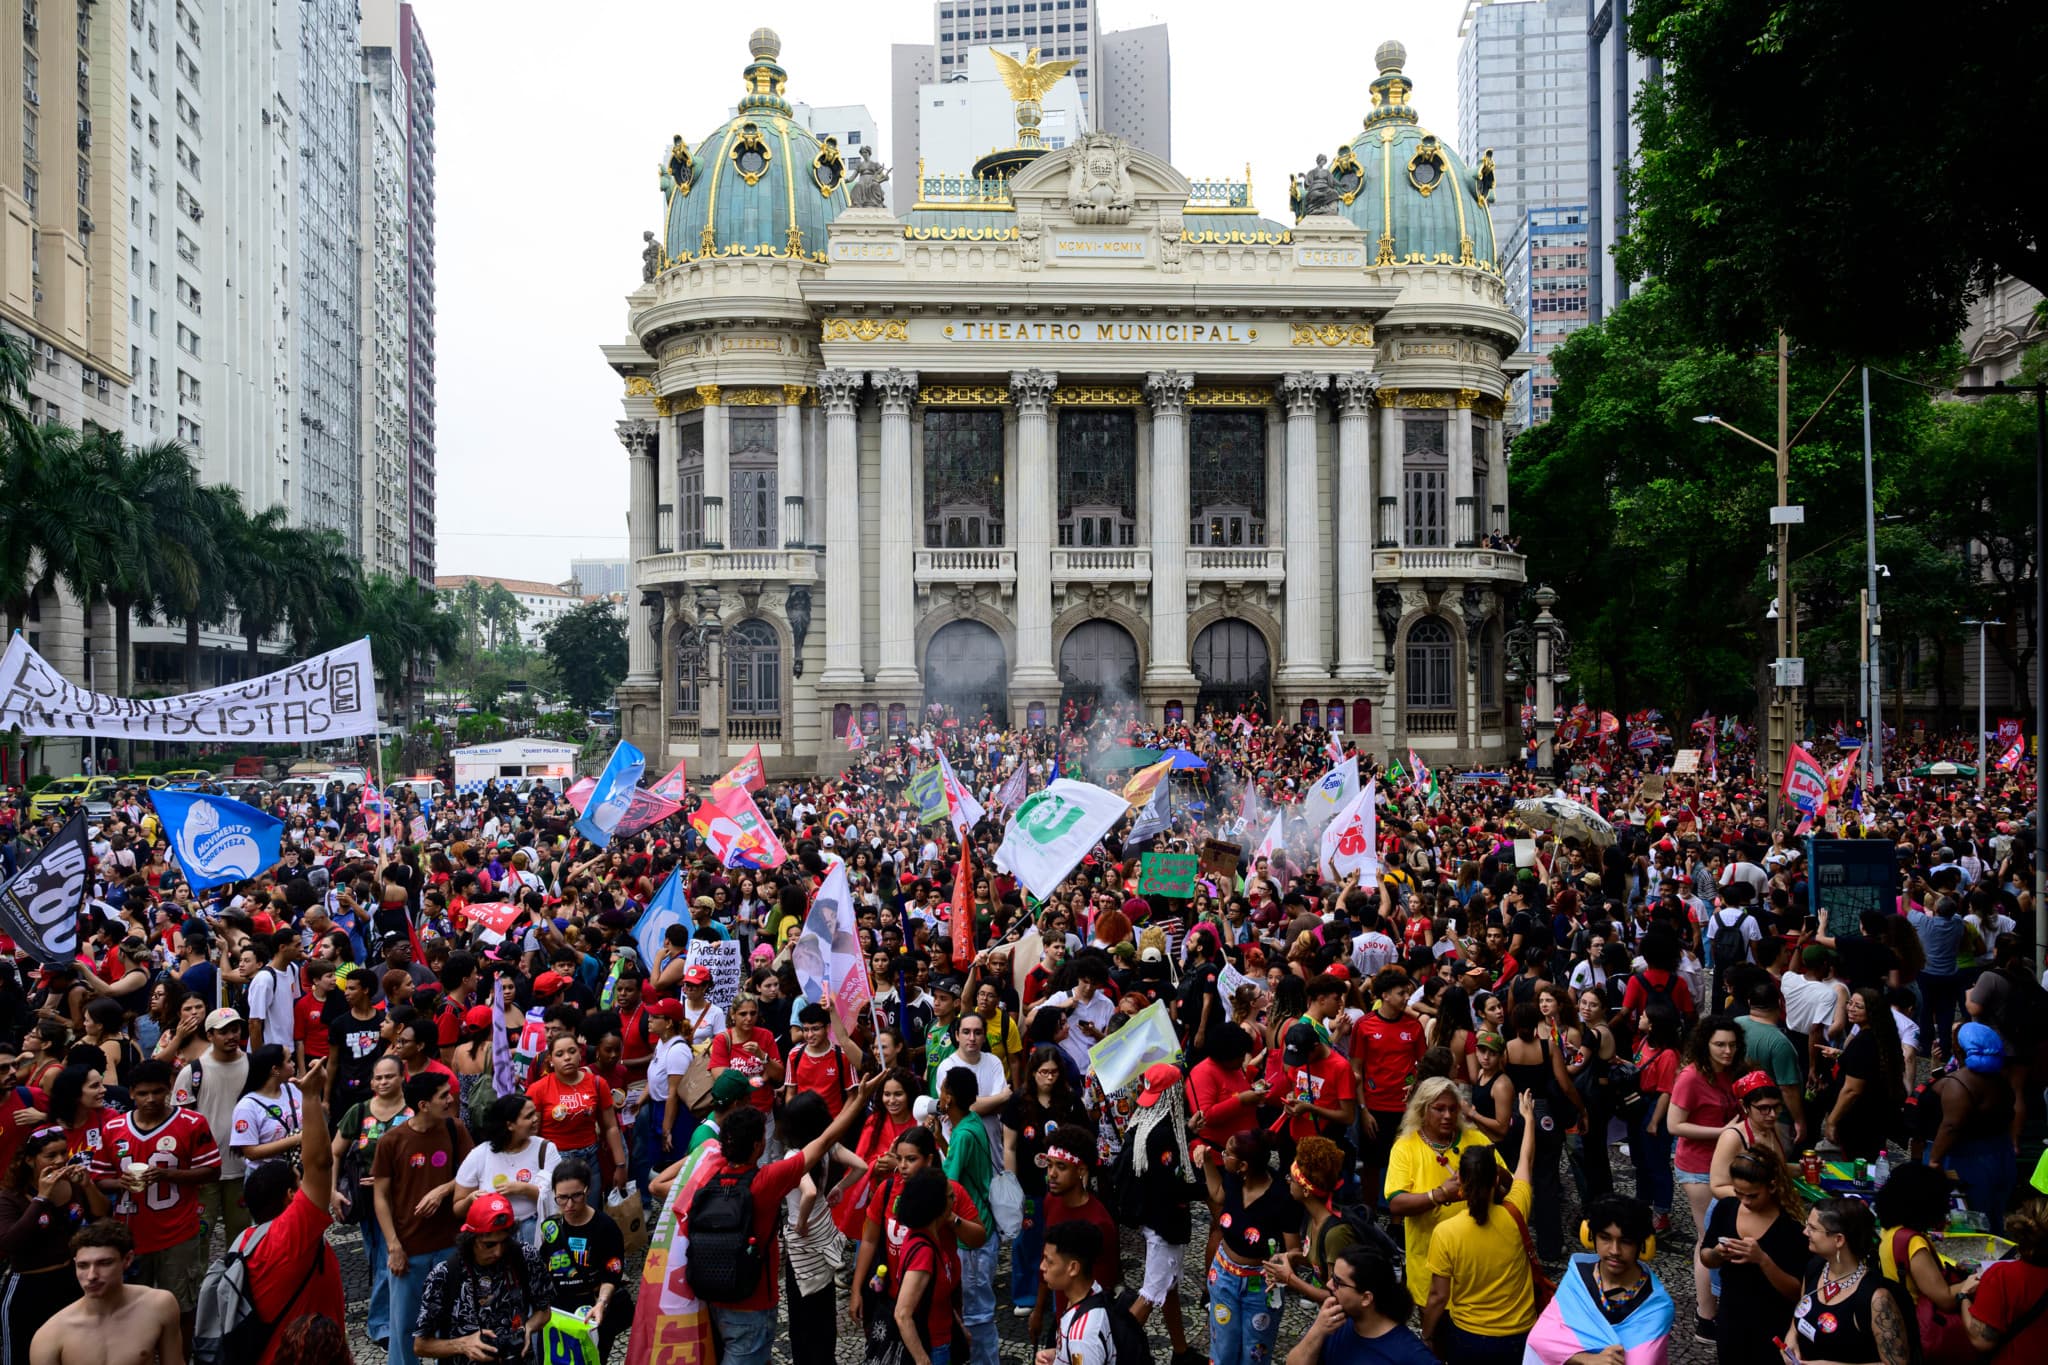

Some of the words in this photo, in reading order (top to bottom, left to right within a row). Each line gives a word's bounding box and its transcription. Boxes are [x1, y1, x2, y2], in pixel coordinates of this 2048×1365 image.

[1058, 241, 1142, 252] MCMVI-MCMIX
[962, 322, 1082, 341] THEATRO
[1096, 323, 1241, 342] MUNICIPAL
[335, 668, 354, 711] DCE
[197, 825, 252, 853] MOVIMENTO
[200, 838, 246, 867] CORRENTEZA
